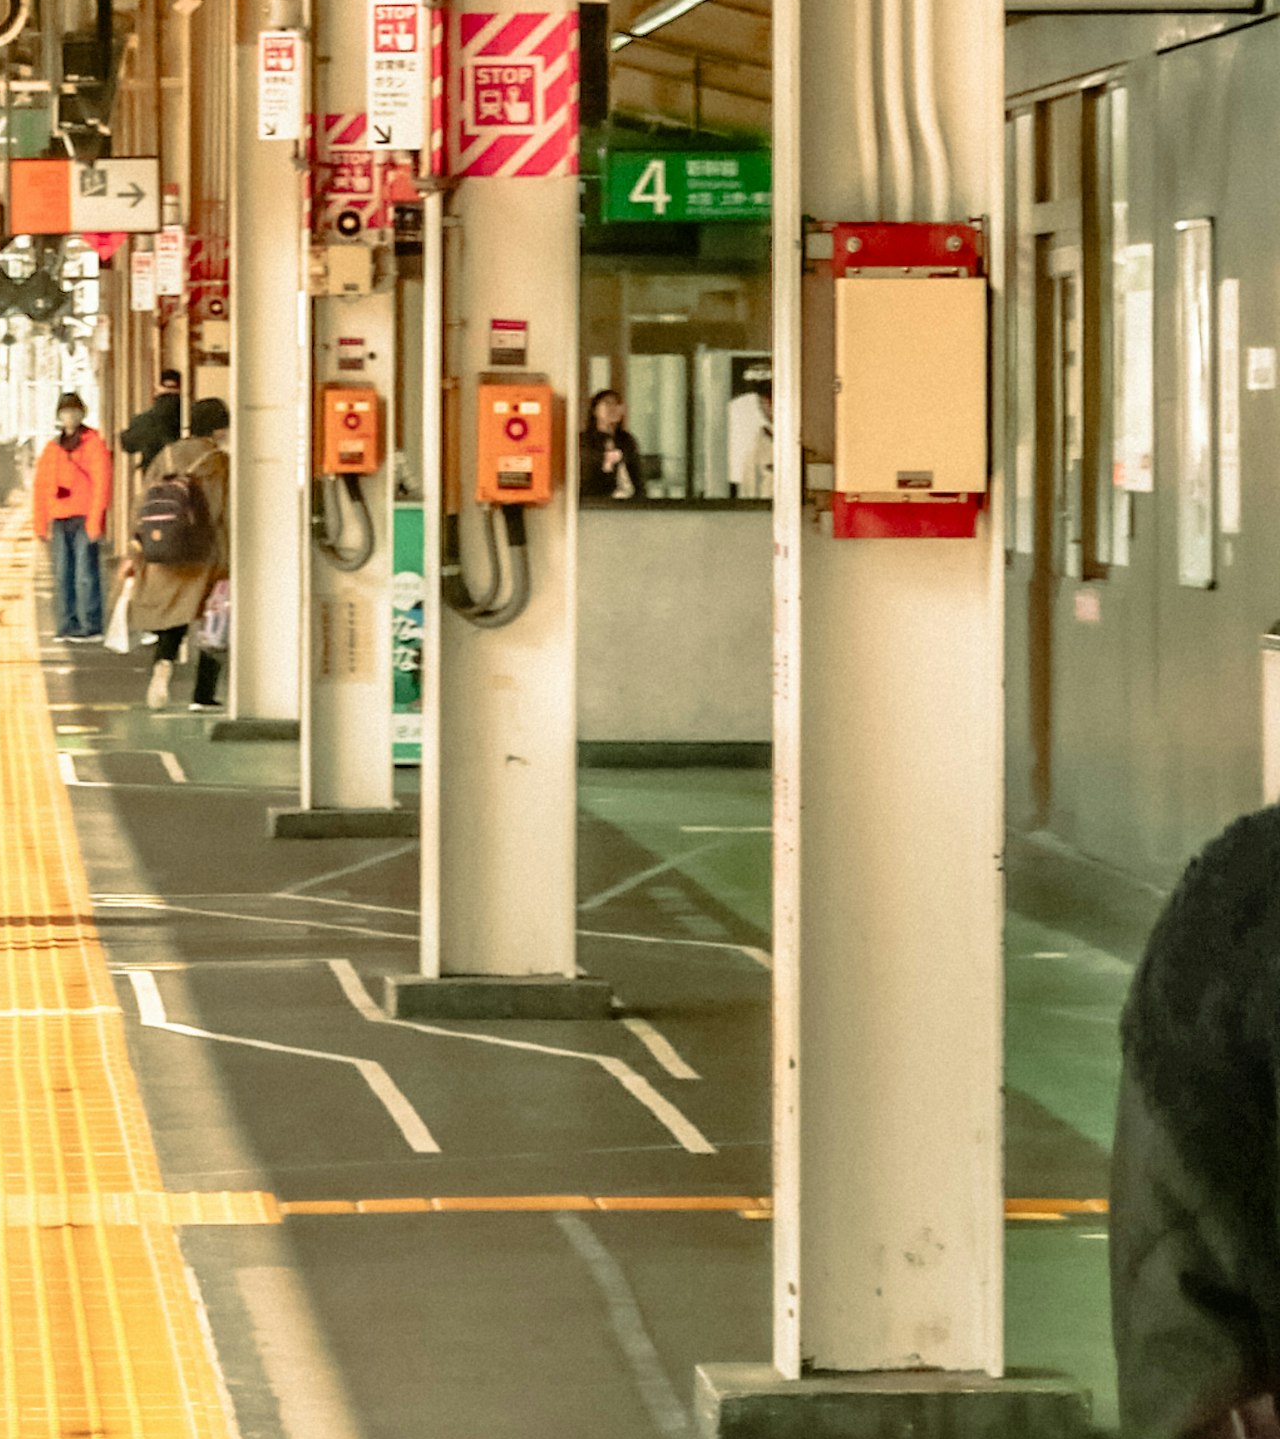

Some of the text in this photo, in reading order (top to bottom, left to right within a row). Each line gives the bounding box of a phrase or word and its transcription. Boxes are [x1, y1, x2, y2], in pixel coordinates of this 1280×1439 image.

[375, 6, 417, 20] STOP
[475, 66, 534, 87] STOP
[628, 159, 672, 215] 4
